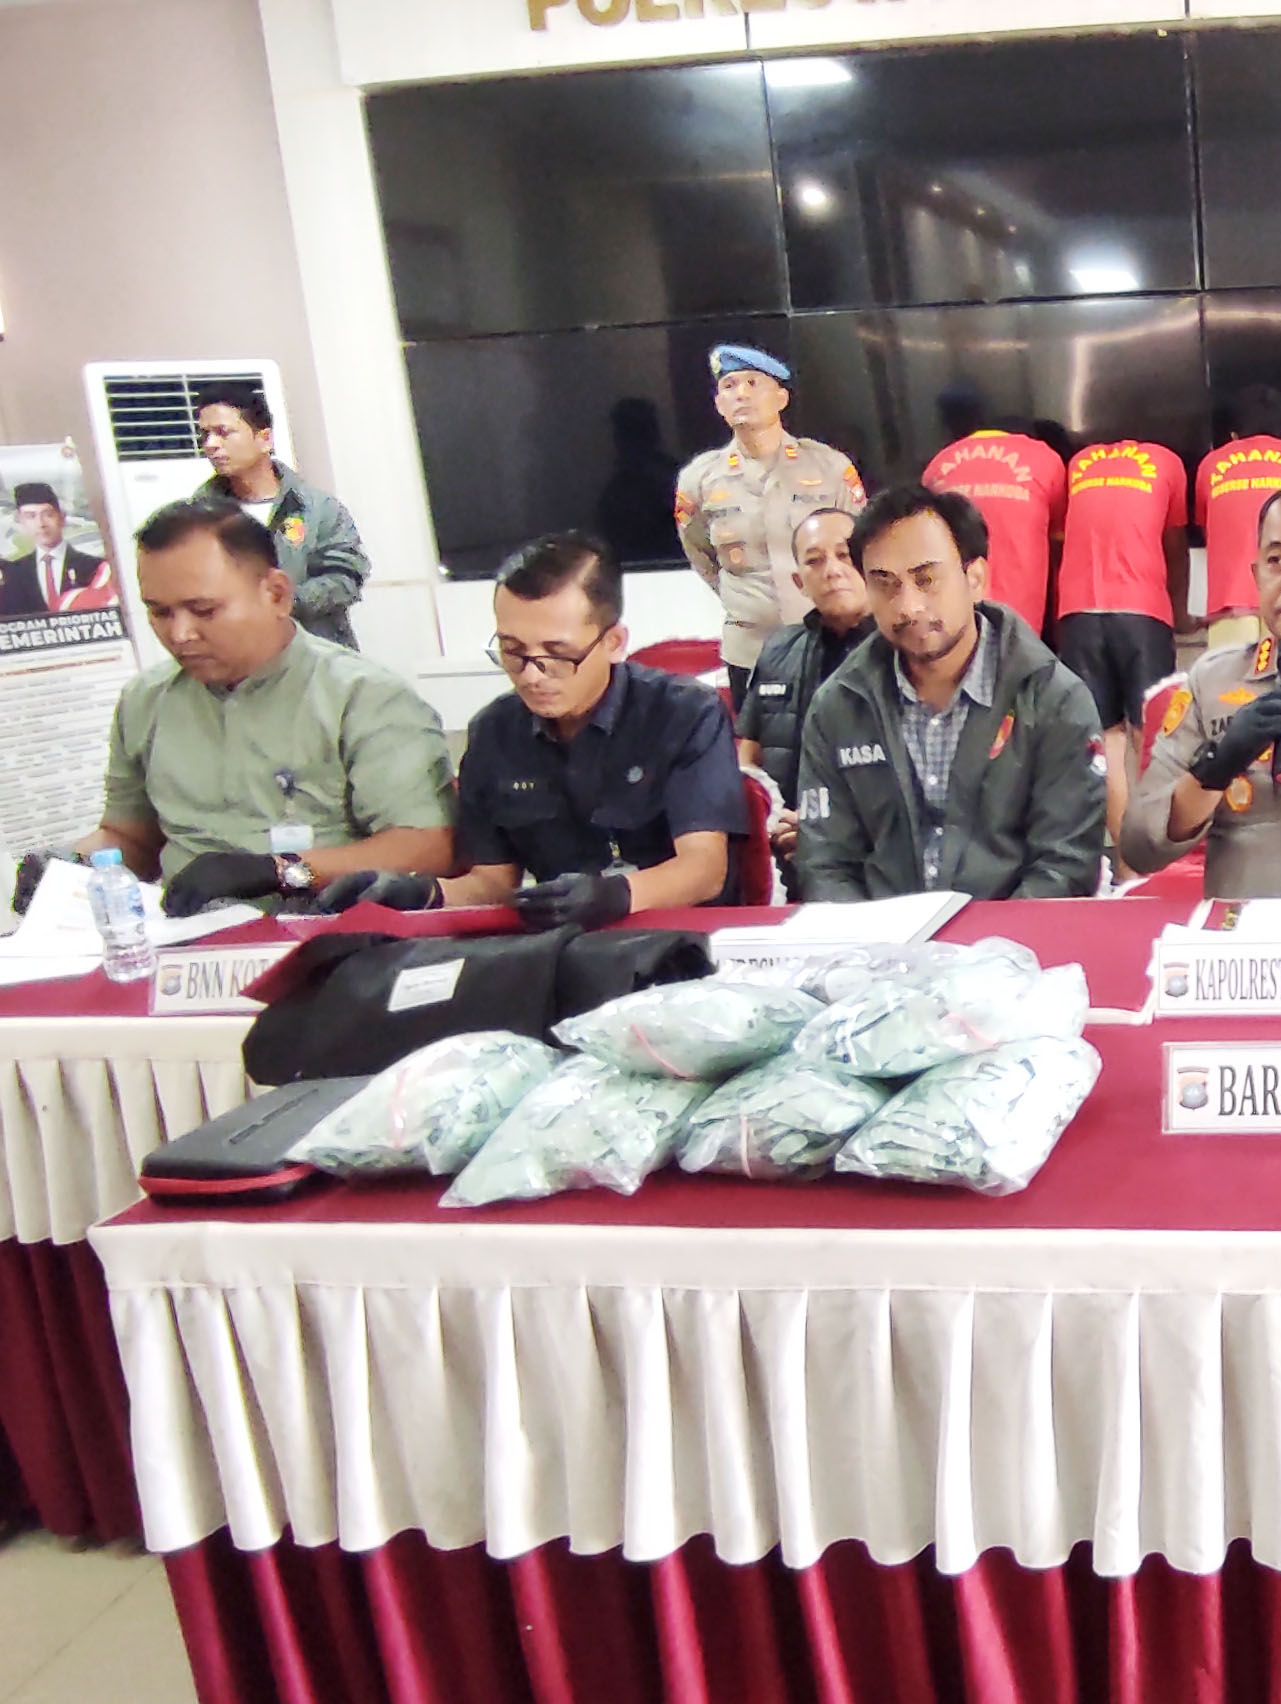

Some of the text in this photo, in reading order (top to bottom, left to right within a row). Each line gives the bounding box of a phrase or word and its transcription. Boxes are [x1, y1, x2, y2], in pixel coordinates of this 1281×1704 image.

[1071, 445, 1158, 484] TAHANAN
[49, 610, 119, 628] PRIORITAS
[839, 743, 886, 766] KASA
[186, 961, 224, 999] BNN
